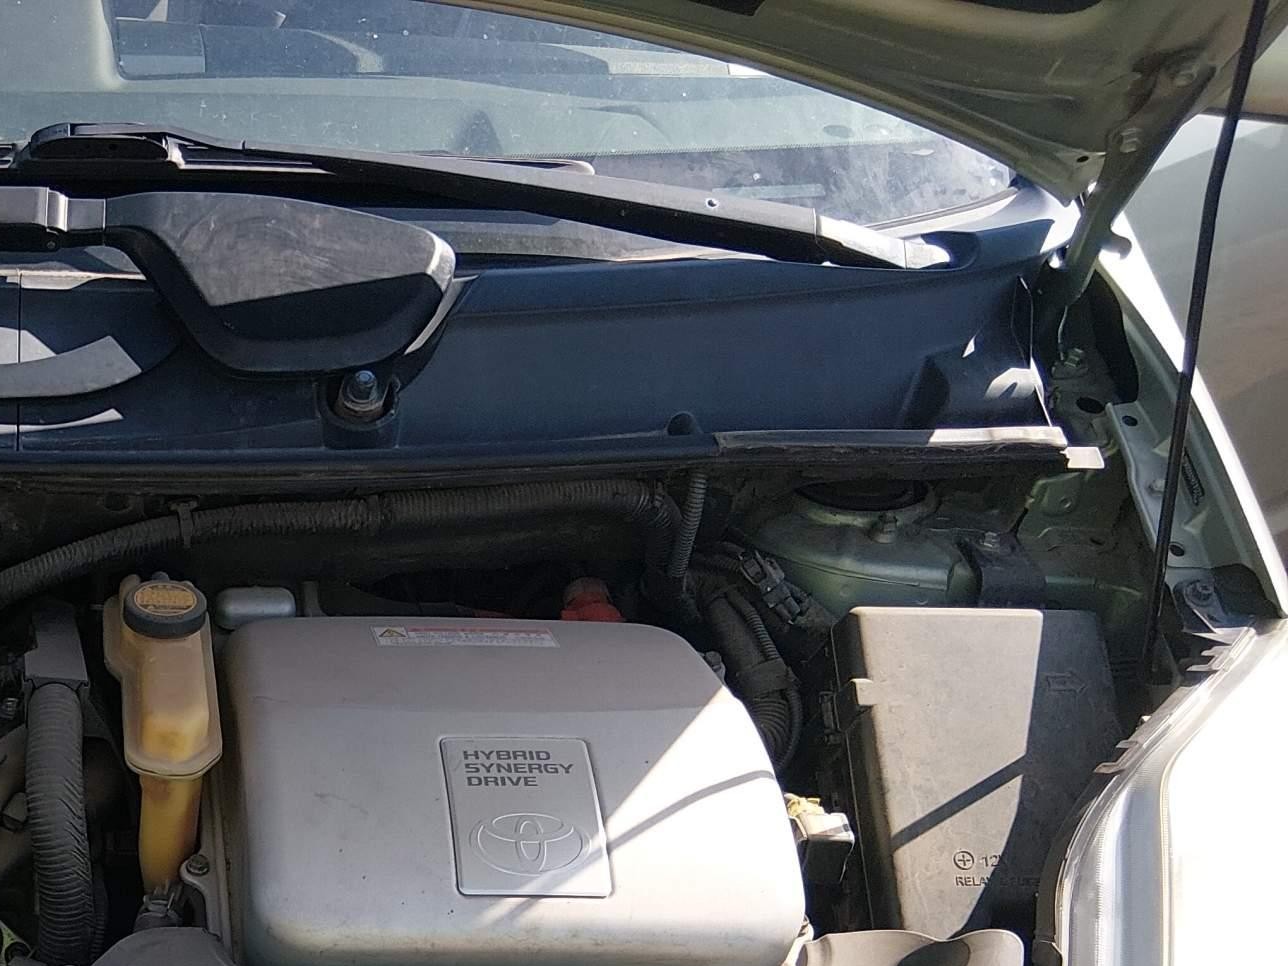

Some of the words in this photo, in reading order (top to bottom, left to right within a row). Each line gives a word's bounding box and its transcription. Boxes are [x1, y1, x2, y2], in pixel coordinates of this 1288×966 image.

[463, 750, 551, 761] HYBRID
[464, 763, 574, 775] SYNERGY
[466, 776, 539, 787] DRIVE
